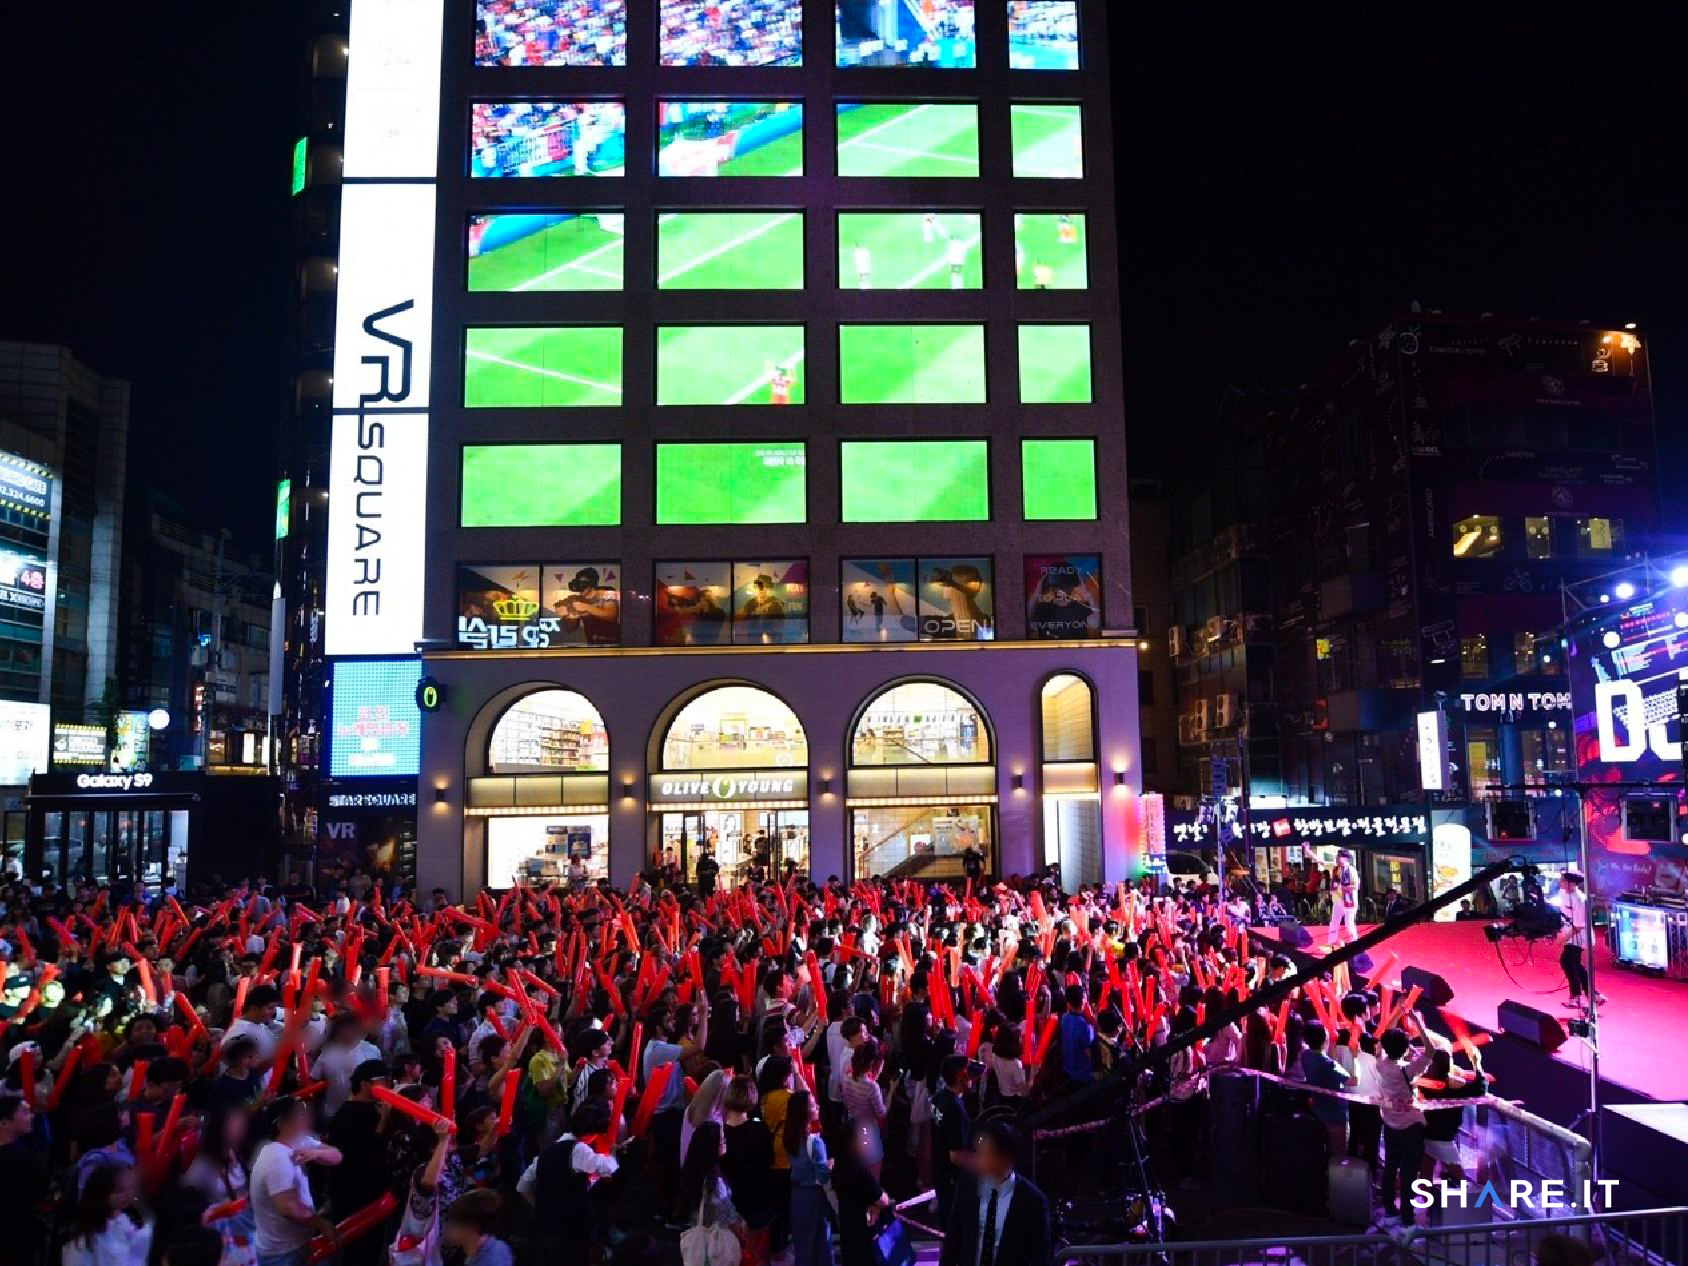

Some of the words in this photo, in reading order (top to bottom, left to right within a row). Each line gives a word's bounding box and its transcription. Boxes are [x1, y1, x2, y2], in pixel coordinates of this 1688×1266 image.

[361, 299, 414, 404] VR
[353, 422, 385, 616] SQUARE
[925, 619, 987, 633] OPEN
[1461, 693, 1505, 711] TOM
[1509, 693, 1523, 711] N
[77, 773, 132, 790] Galaxy
[134, 773, 153, 787] S9
[662, 781, 709, 795] OLIVE
[738, 780, 793, 794] YOUNG
[328, 794, 363, 807] STAR
[364, 793, 417, 806] SQUARE
[326, 822, 355, 839] VR
